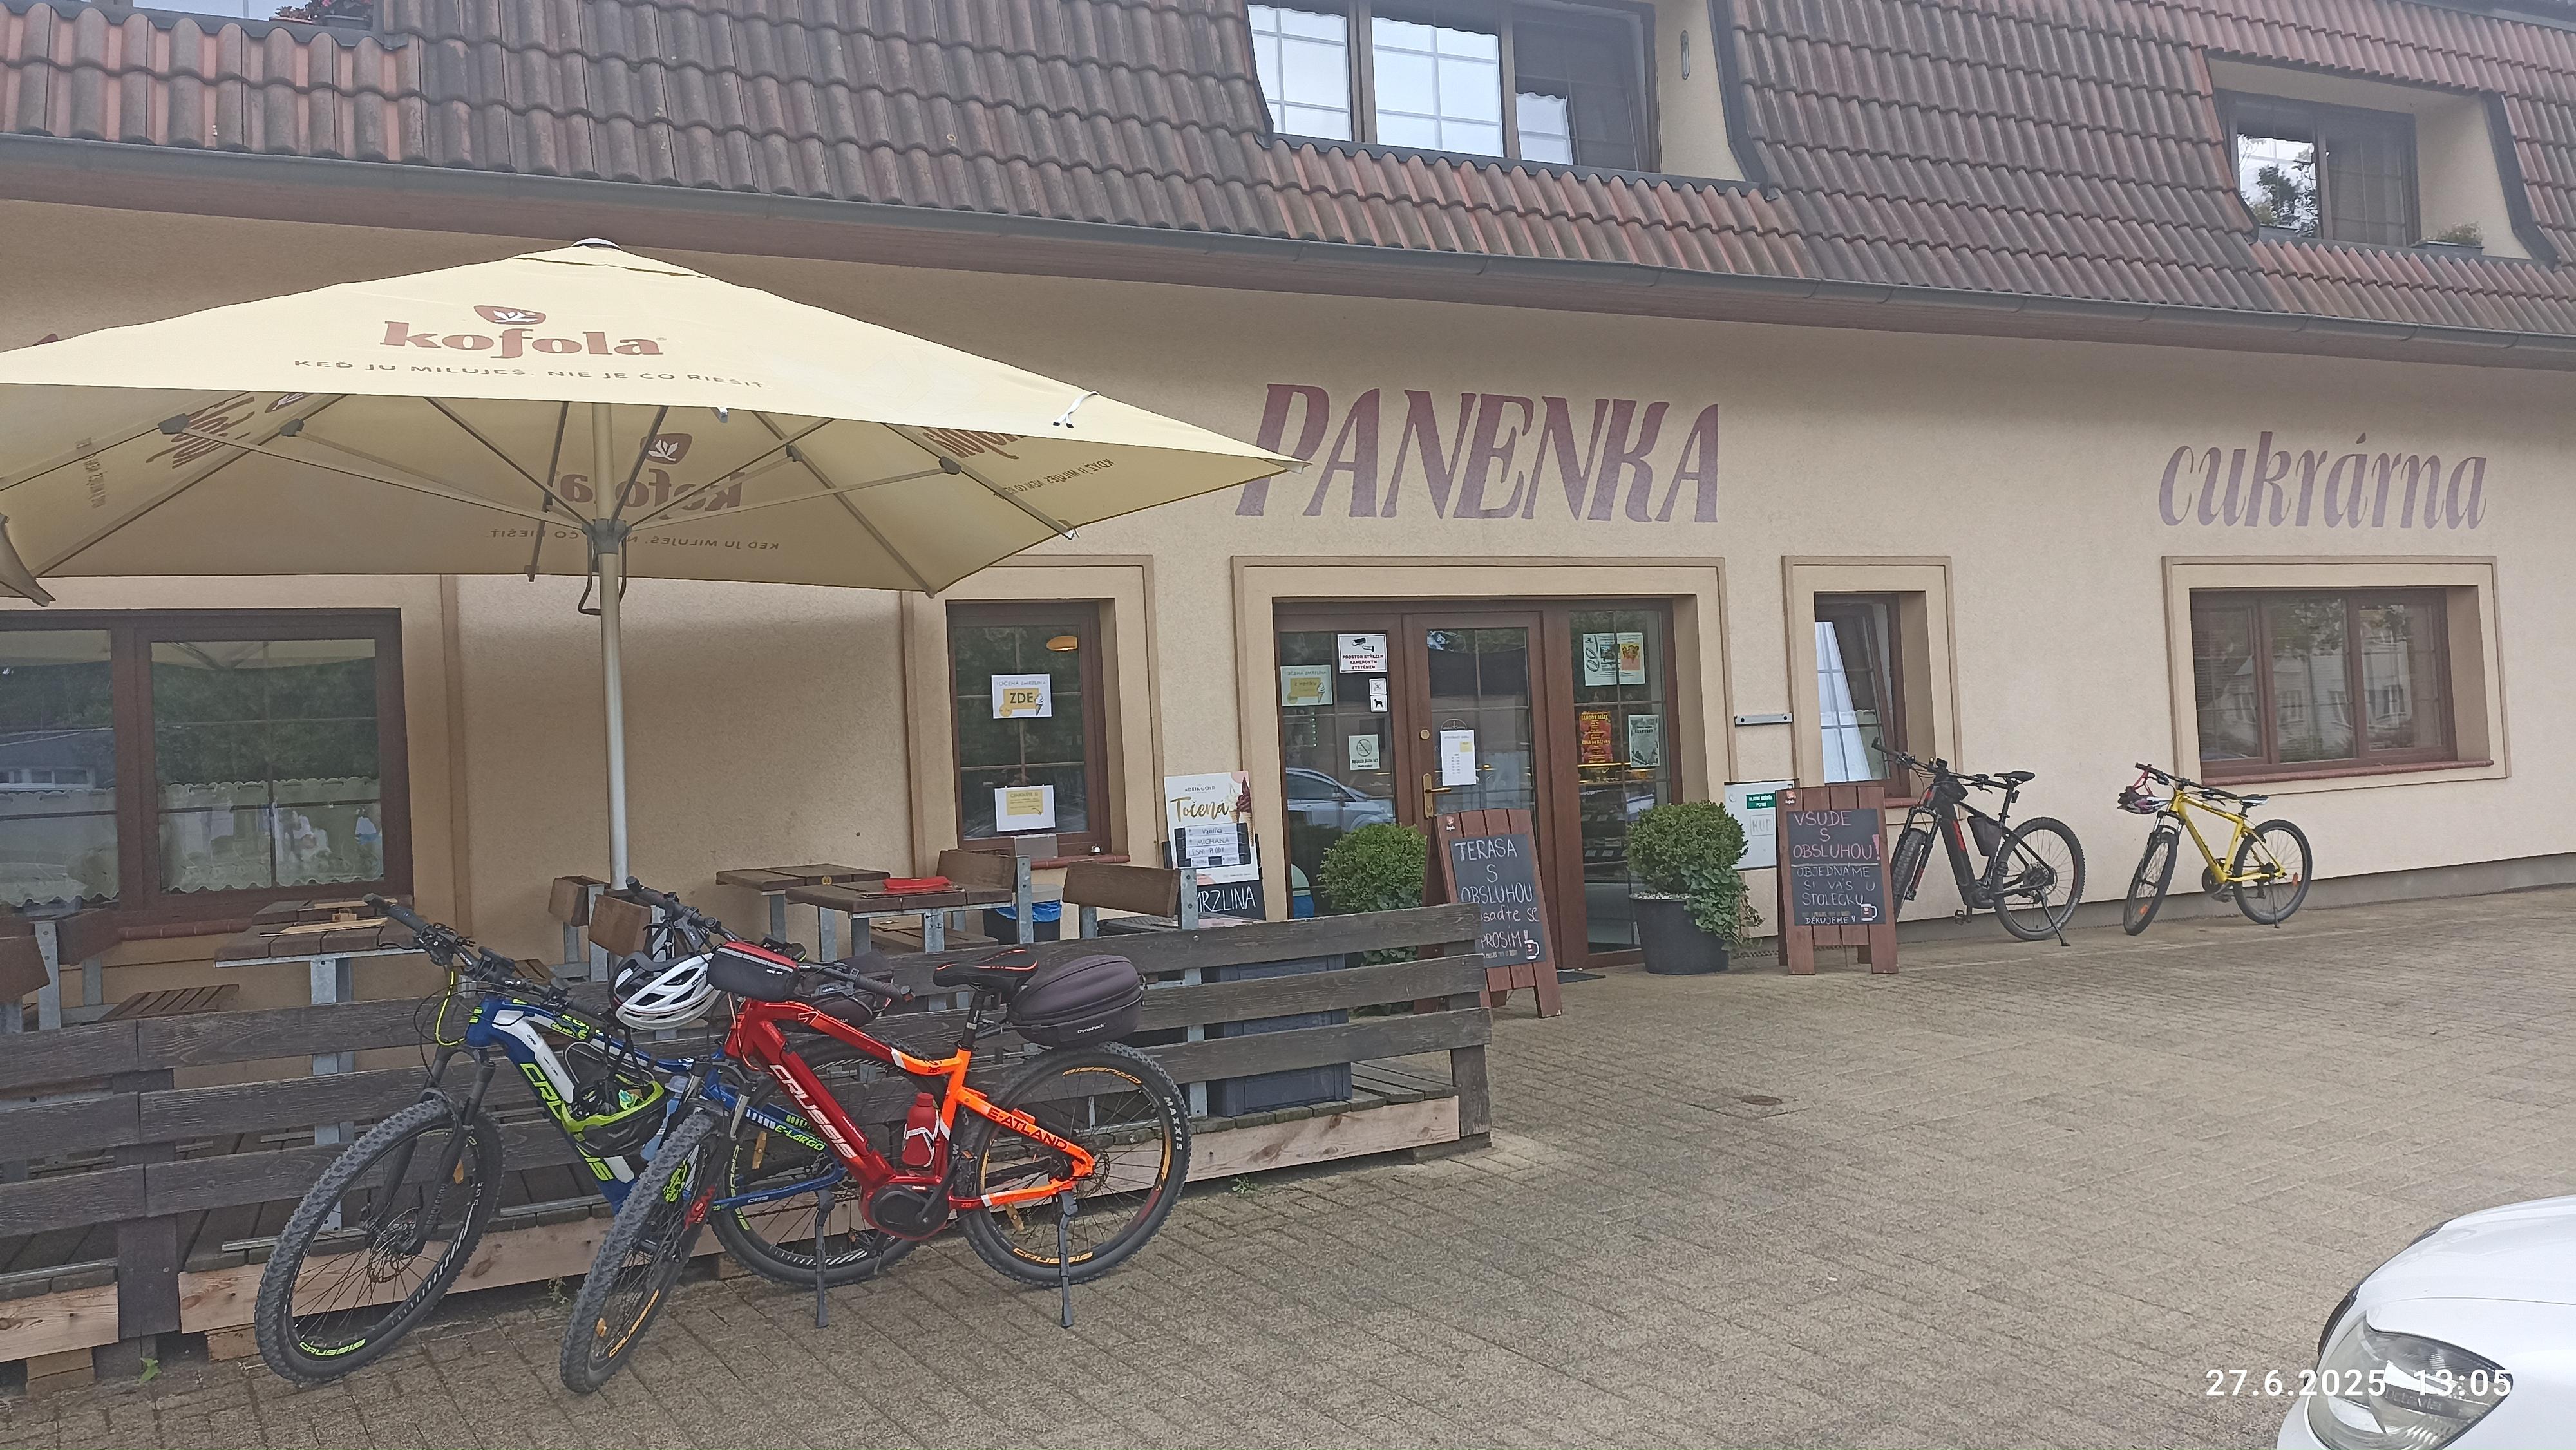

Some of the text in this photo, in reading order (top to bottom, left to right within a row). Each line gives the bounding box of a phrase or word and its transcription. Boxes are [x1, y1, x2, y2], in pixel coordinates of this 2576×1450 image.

[380, 321, 663, 358] kofola
[1235, 384, 1718, 523] PANENKA
[2159, 431, 2487, 529] cukrárna
[1010, 692, 1034, 704] ZDE
[1170, 796, 1229, 822] Točená
[1820, 828, 1830, 842] S
[1454, 838, 1517, 861] TERASA
[1486, 864, 1498, 883] S
[1828, 878, 1853, 890] VÁS
[1461, 883, 1533, 904] OBSLUHOU
[1802, 890, 1863, 905] STOLEČKU
[769, 1064, 857, 1158] CRUSSIS
[987, 1107, 1068, 1150] E-ATLAND
[1164, 1097, 1183, 1151] MAXXIS
[775, 1125, 825, 1151] E-LARGO
[299, 1339, 366, 1356] CRUSSIS
